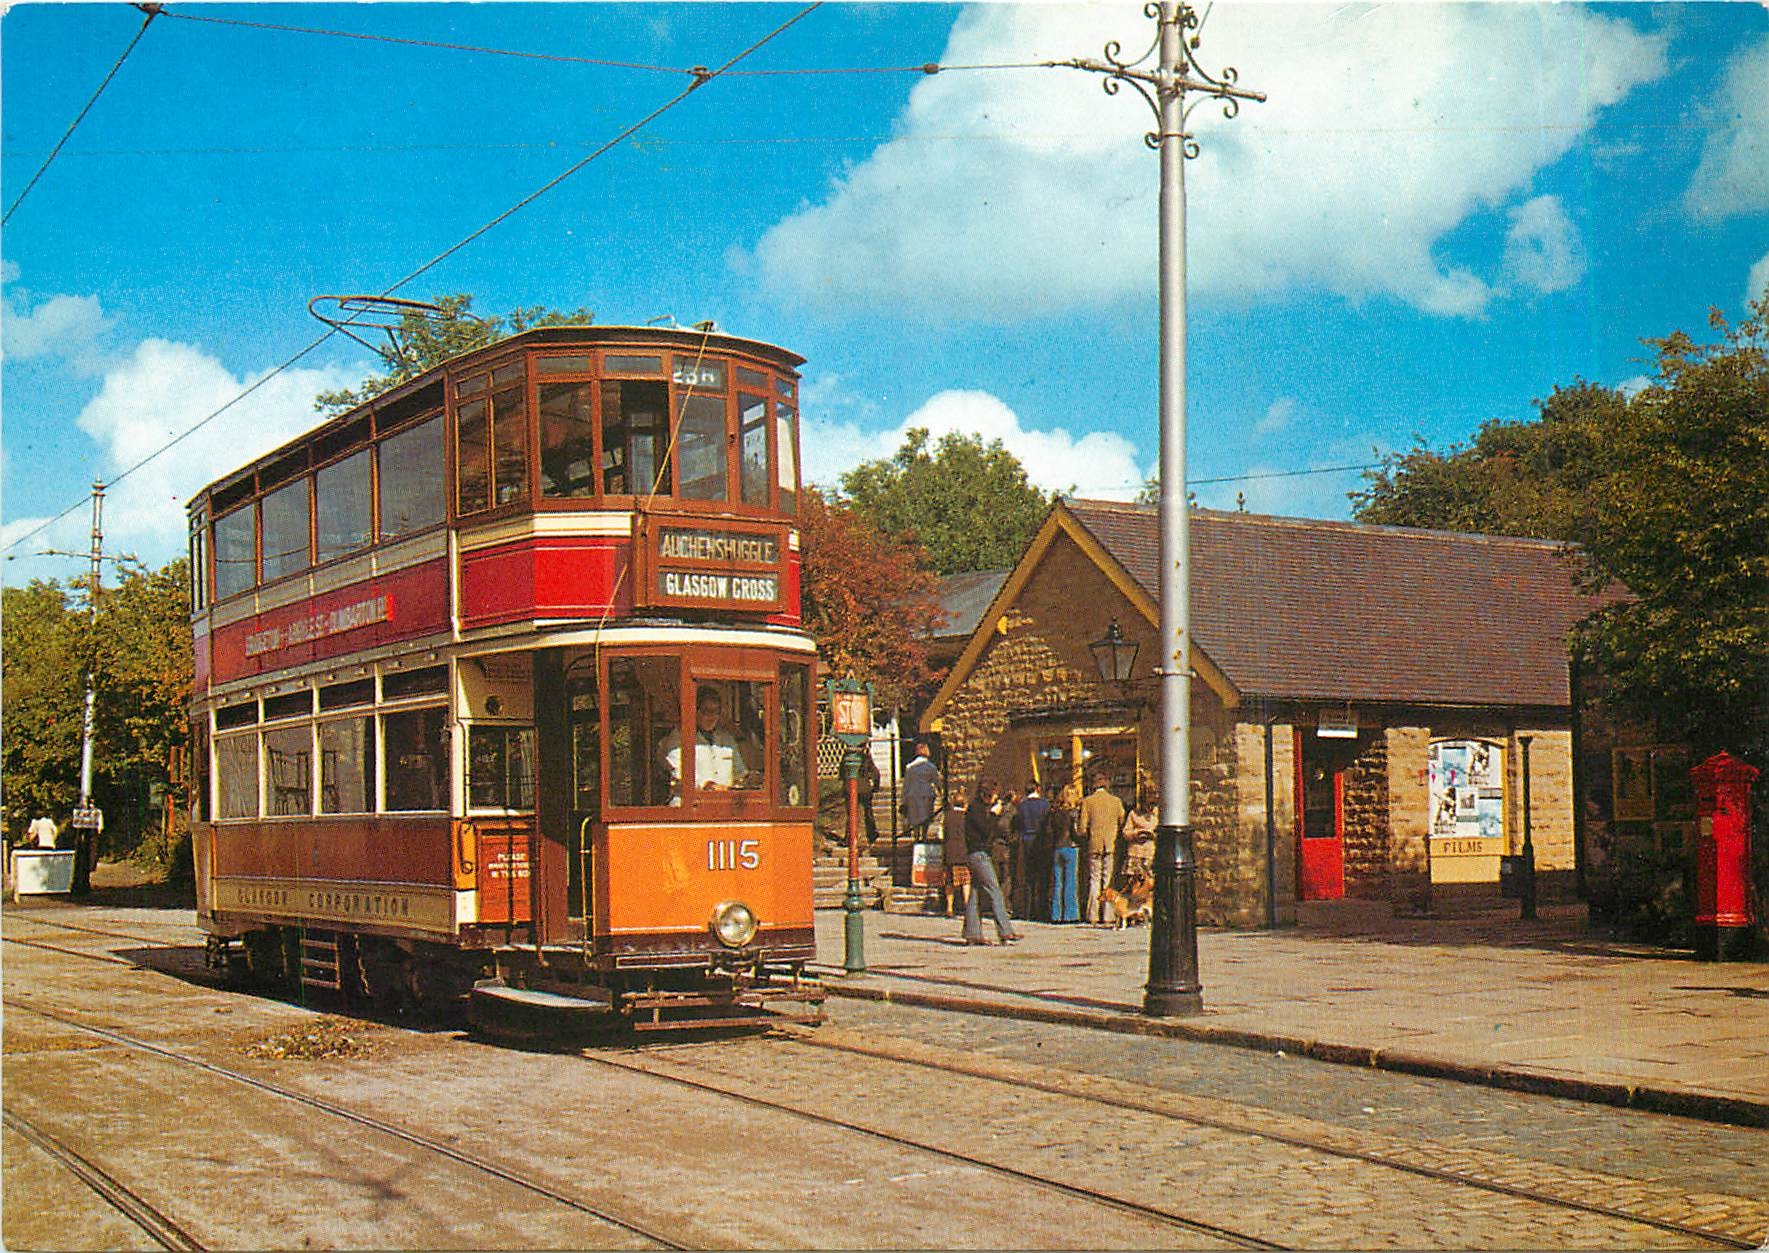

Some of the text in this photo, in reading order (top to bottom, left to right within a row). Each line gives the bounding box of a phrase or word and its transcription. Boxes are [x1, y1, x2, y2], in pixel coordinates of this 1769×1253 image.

[663, 534, 774, 564] AUCHENSHUGGLE
[666, 573, 774, 601] GLASGOW CROSS
[498, 853, 527, 861] PLASE
[708, 839, 760, 870] 1115
[1443, 841, 1483, 853] FILMS
[308, 891, 409, 917] CORPORATION
